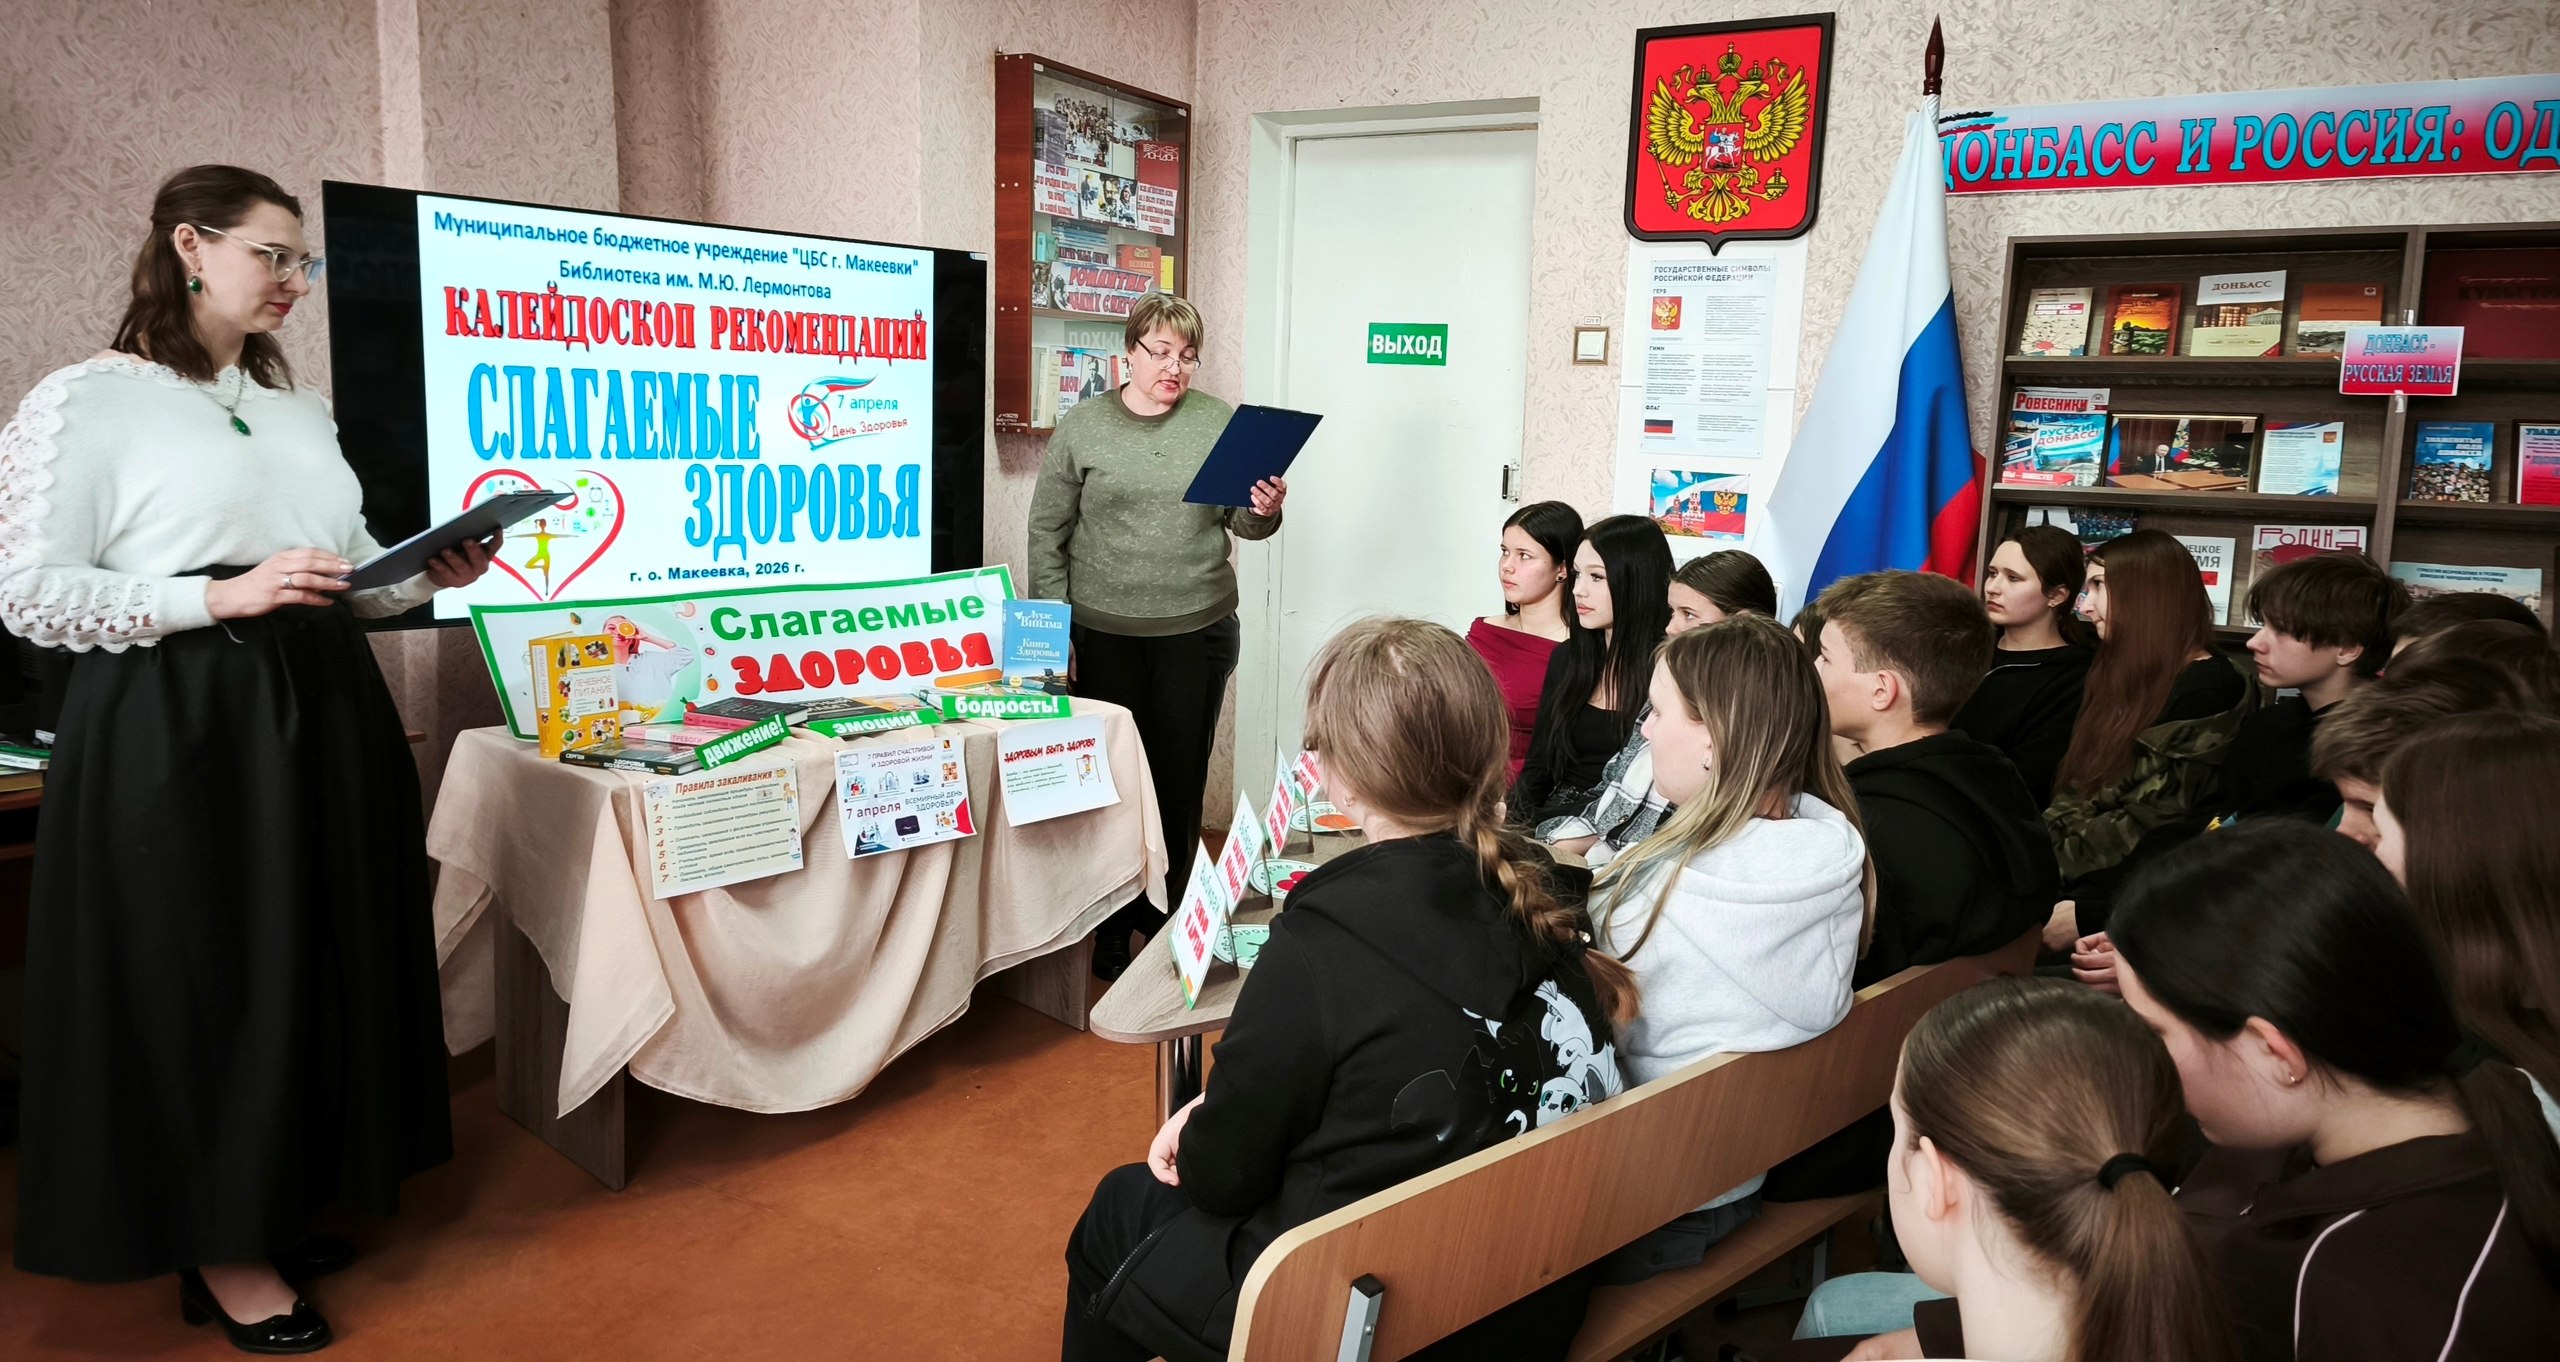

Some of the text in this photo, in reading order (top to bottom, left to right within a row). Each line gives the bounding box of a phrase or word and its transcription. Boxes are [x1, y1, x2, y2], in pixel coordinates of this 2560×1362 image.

[2177, 118, 2216, 172] И
[2233, 105, 2464, 170] РОССИЯ:
[2484, 98, 2560, 168] ОД
[435, 212, 918, 275] Муниципальное бюджетное учреждение "ЦБС г. Макеевки"
[560, 261, 831, 299] Библиотека им. М.Ю. Лермонтова
[1654, 274, 1754, 282] РОССИЙСКОЙ ФЕДЕРАЦИИ
[2212, 281, 2272, 291] ДОНБАСС
[444, 281, 927, 366] КАЛЕЙДОСКОП РЕКОМЕНДАЦИЙ
[1372, 334, 1442, 359] ВЫХОД
[2363, 334, 2428, 355] ДОНБАСС
[2344, 364, 2453, 383] РУССКАЯ ЗЕМЛЯ
[468, 363, 760, 460] СЛАГАЕМЫЕ
[837, 395, 898, 413] 7 апреля
[832, 419, 907, 437] День Здоровья
[2038, 431, 2098, 445] ДОНБАСС!
[684, 464, 920, 562] ЗДОРОВЬЯ
[630, 561, 805, 583] г. о. Макеевка, 2026 г.
[711, 594, 985, 643] Слагаемые
[1023, 638, 1050, 648] Книга
[1016, 646, 1060, 658] Здоровья
[729, 631, 994, 696] ЗДОРОВЬЯ
[574, 675, 612, 687] ЛЕЧЕБНОЕ
[574, 685, 612, 698] ПИТАНИЕ
[955, 695, 1060, 719] бодрость!
[832, 711, 922, 734] эмоции!
[672, 734, 703, 744] ТРЕВОГИ
[703, 714, 786, 768] движение!
[872, 751, 897, 760] ПРАВИЛ
[898, 745, 935, 756] СЧАСТЛИВОЙ
[1004, 738, 1096, 762] ЗДОРОВЫМ БЫТЬ ЗДОРОВО
[878, 758, 910, 768] ЗДОРОВОЙ
[911, 754, 933, 763] ЖИЗНИ
[675, 771, 773, 795] Правила закаливания
[905, 790, 963, 805] ВСЕМИРНЫЙ ДЕНЬ
[916, 799, 954, 812] ЗДОРОВЬЯ
[653, 803, 660, 812] 1
[846, 803, 901, 820] 7 апреля
[655, 828, 663, 836] 3
[656, 839, 664, 848] 4
[658, 850, 666, 859] 5
[659, 862, 666, 870] 6
[661, 874, 669, 882] 7
